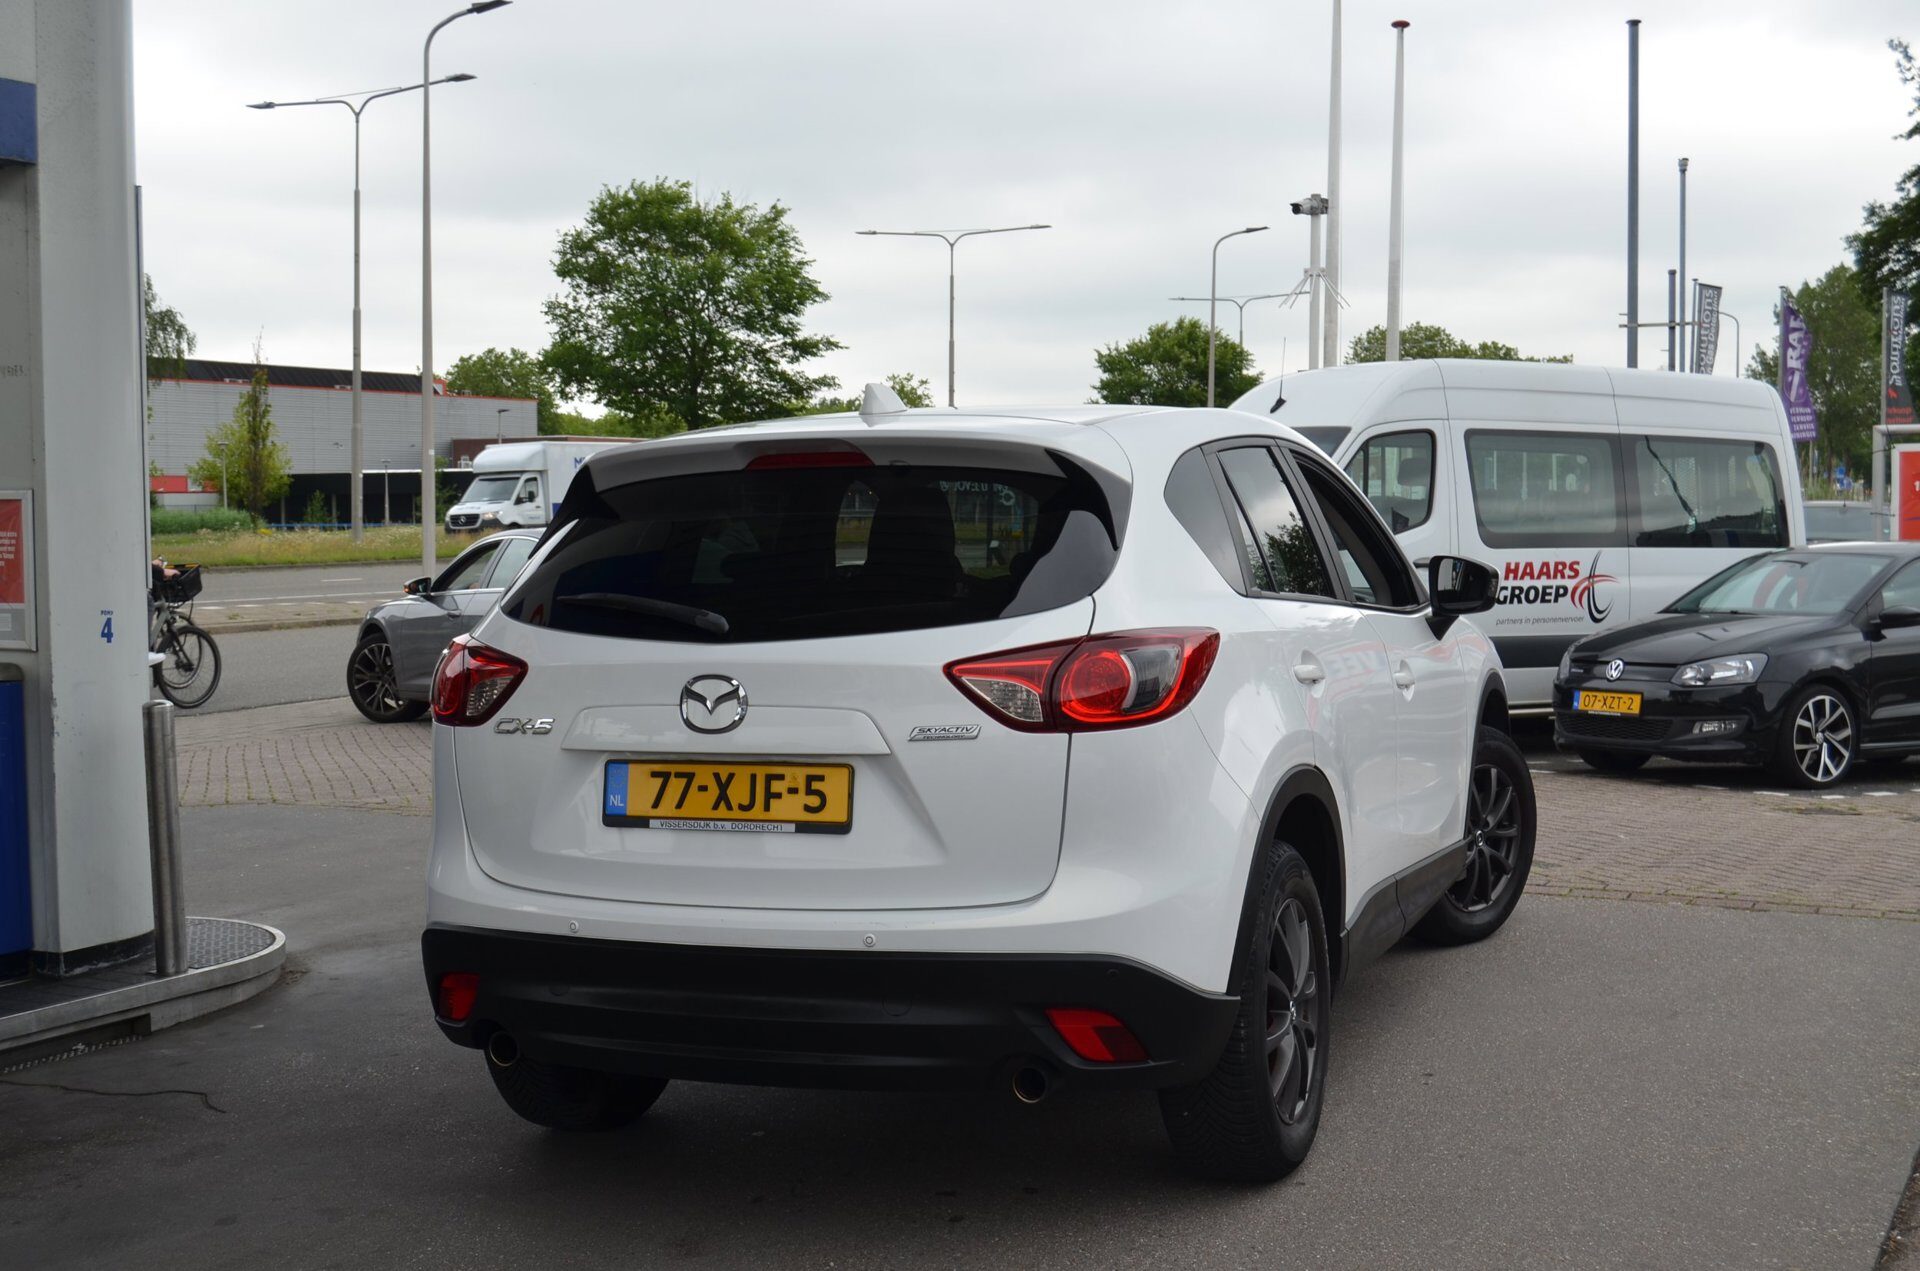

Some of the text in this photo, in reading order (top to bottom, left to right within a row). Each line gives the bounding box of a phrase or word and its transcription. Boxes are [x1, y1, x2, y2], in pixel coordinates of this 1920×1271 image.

[1504, 560, 1580, 581] HAARS
[1496, 584, 1569, 605] GROEP
[100, 616, 114, 644] 4
[1496, 615, 1584, 626] partners in personenvervoer
[1583, 694, 1634, 710] 07-XZT-2
[494, 718, 556, 735] CX-5
[610, 771, 828, 814] NL 77-XJF-5
[659, 820, 712, 830] VISSERSDIJK
[730, 822, 784, 832] DORDRECHT
